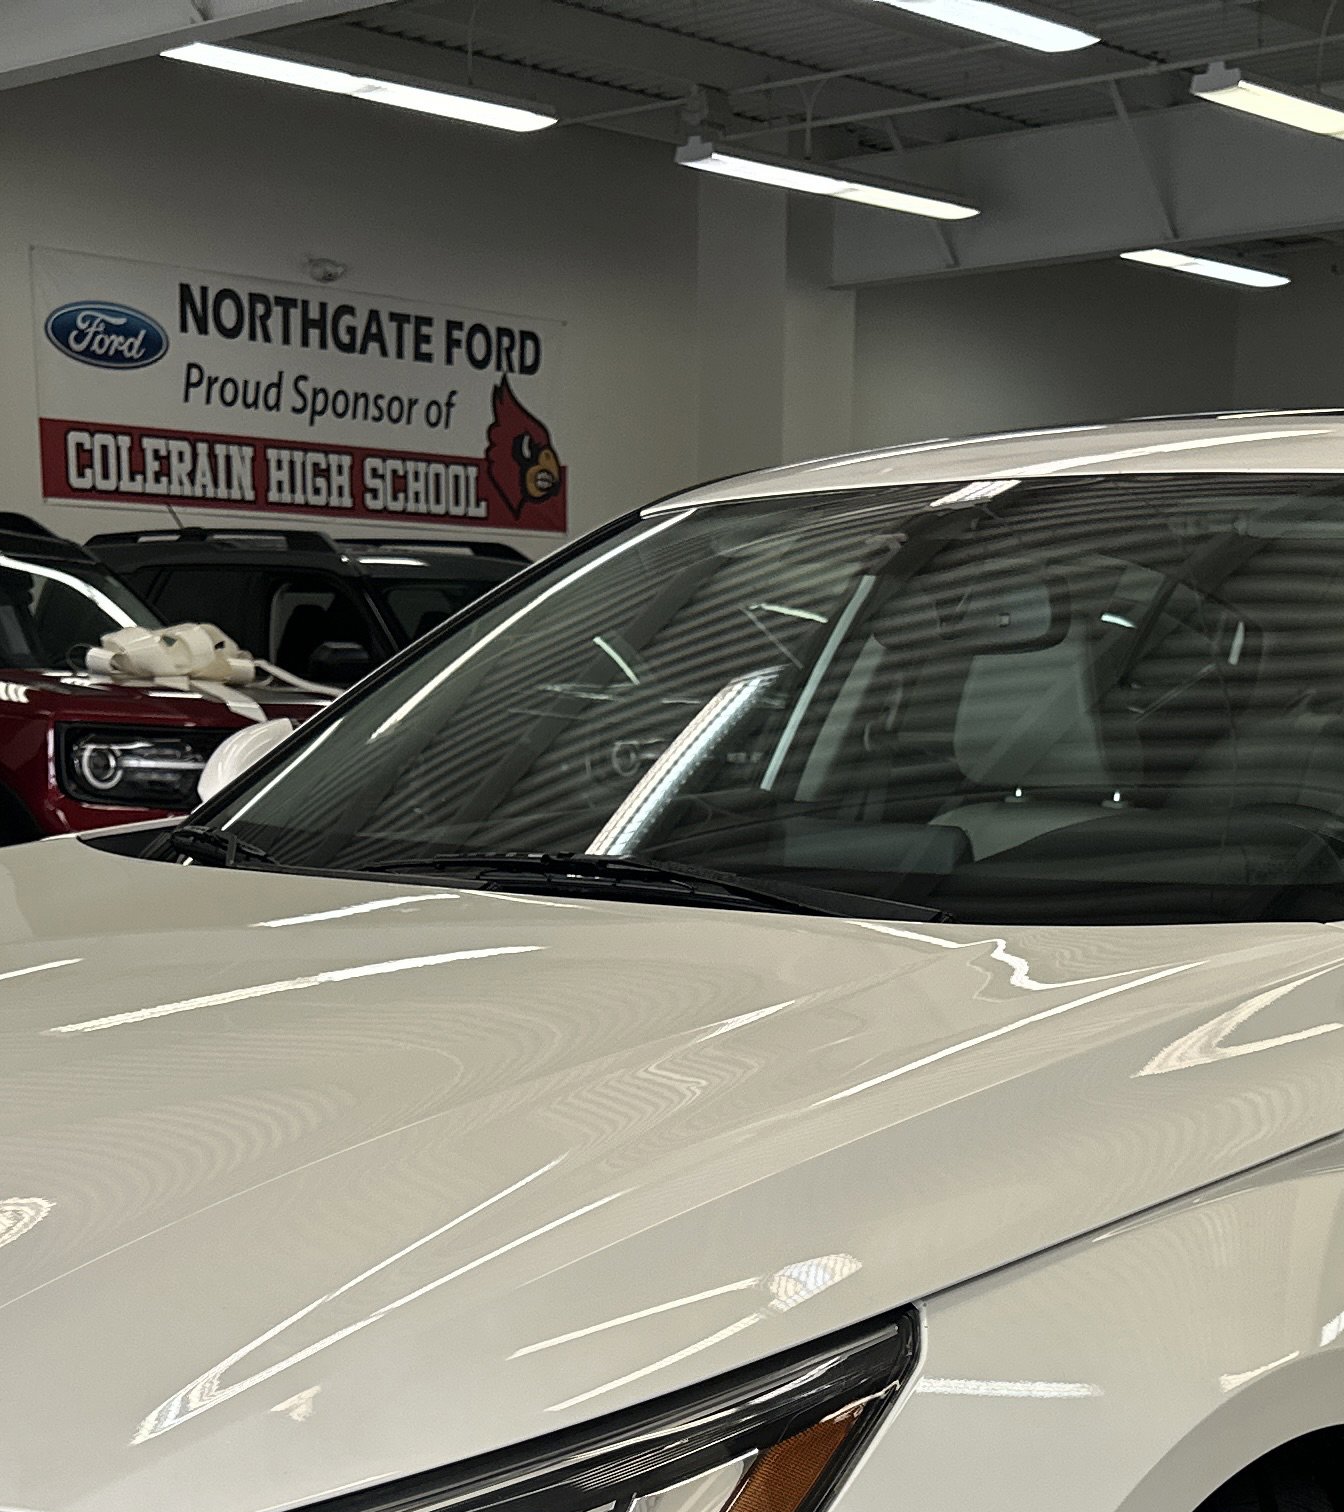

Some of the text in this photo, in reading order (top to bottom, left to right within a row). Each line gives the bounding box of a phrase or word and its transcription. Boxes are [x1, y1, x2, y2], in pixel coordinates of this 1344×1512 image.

[65, 309, 148, 361] Ford
[178, 282, 542, 376] NORTHGATE FORD
[183, 362, 458, 430] Proud Sponsor of
[65, 430, 488, 519] COLERAIN HIGH SCHOOL
